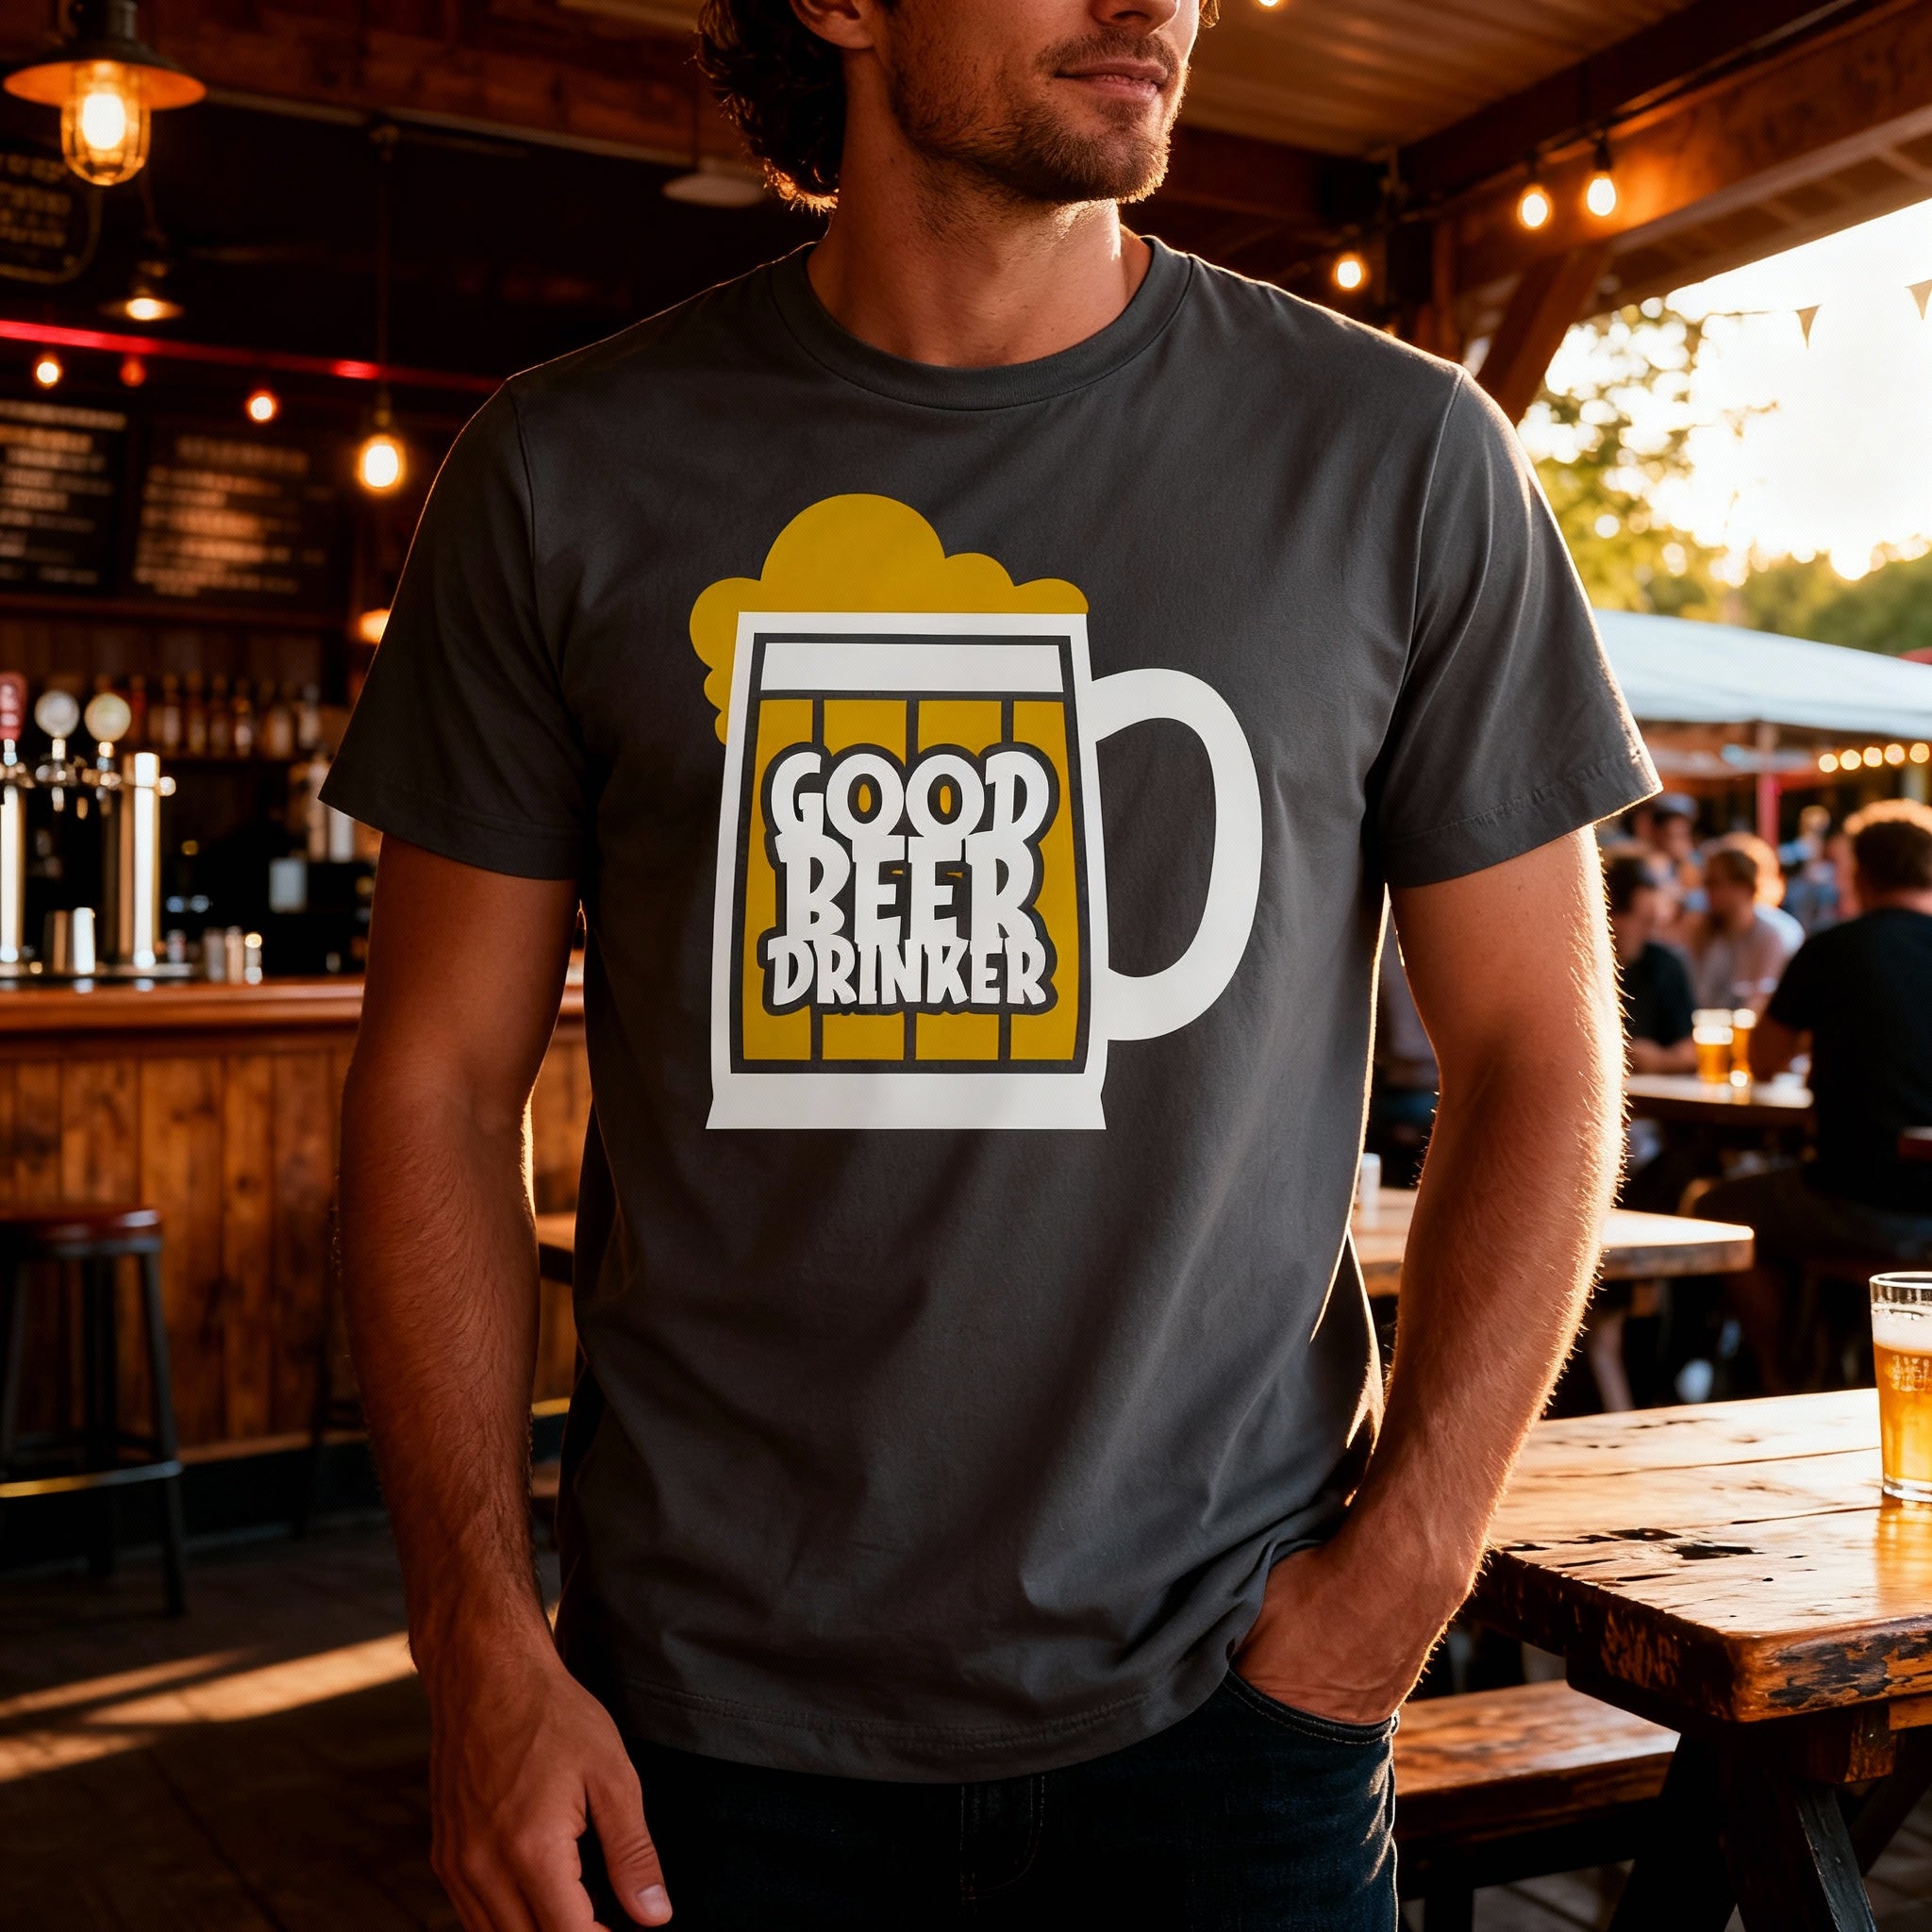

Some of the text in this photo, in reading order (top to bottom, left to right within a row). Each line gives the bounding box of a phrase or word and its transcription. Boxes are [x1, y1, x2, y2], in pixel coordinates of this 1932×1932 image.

[771, 751, 1049, 839] GOOD
[775, 831, 1038, 943] BEER
[767, 935, 1047, 1006] DRINKER
